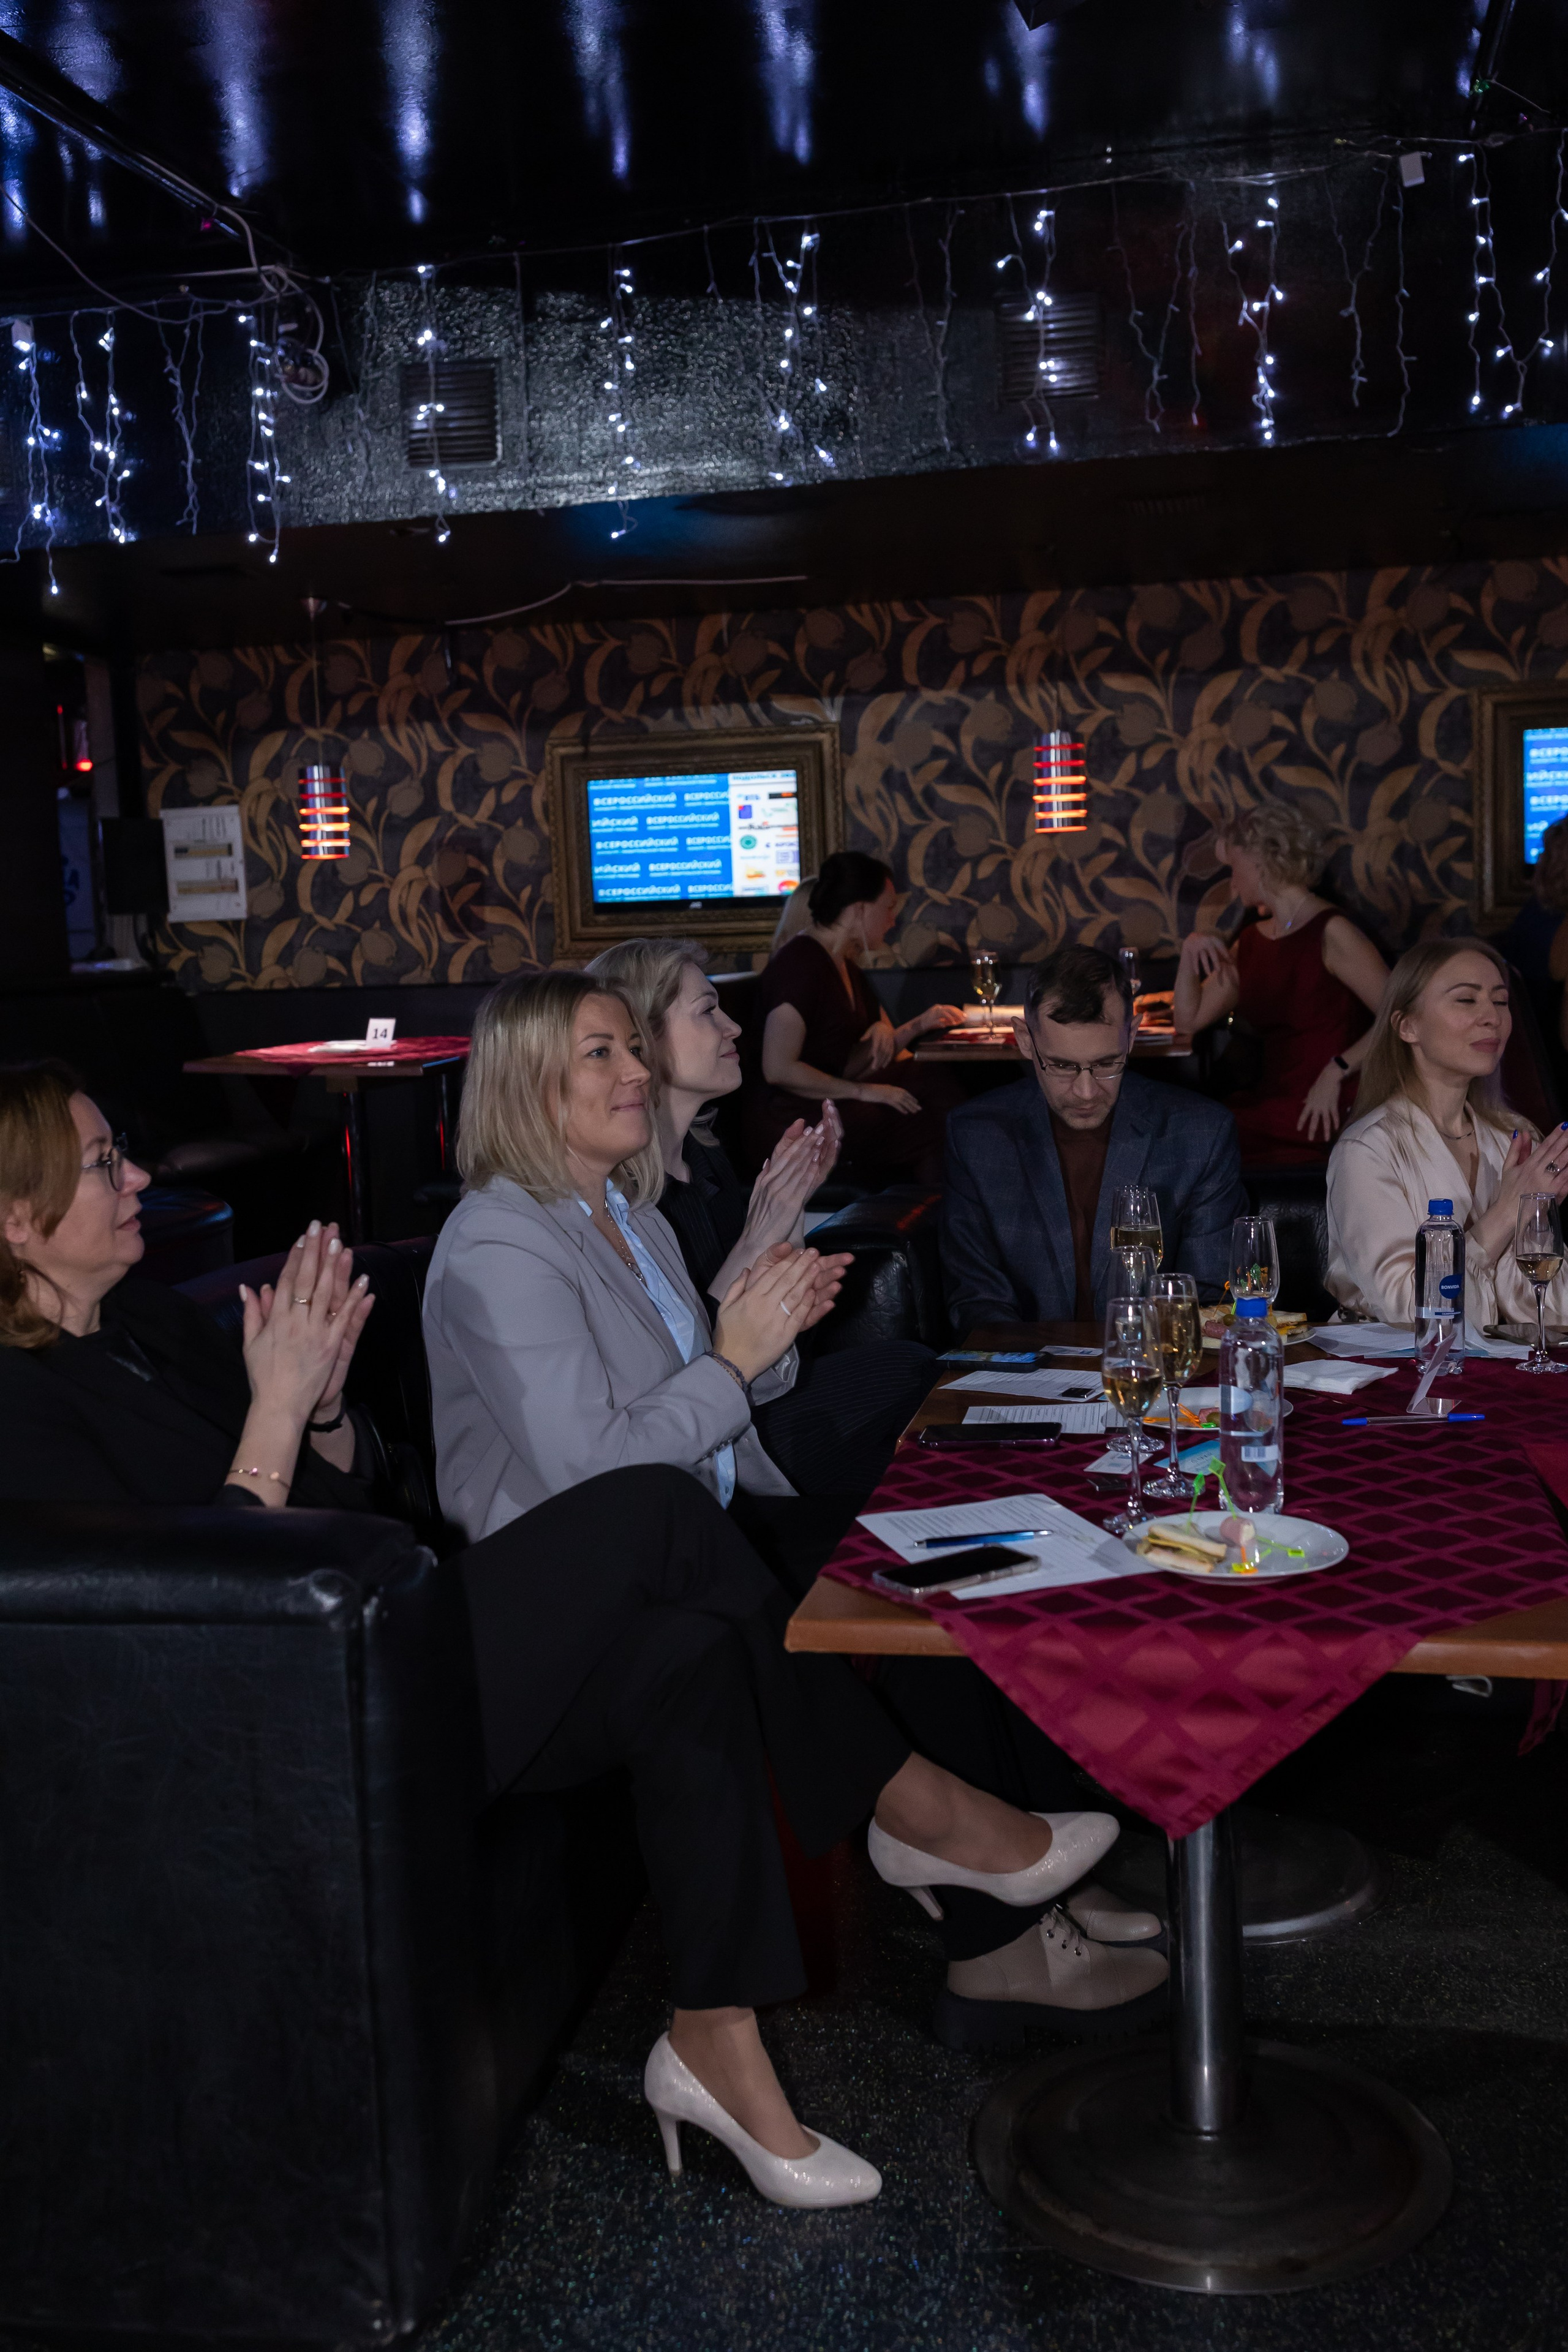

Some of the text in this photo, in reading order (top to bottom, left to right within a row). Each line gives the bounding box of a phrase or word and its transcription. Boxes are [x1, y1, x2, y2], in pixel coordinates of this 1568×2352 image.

[594, 792, 677, 806] ВСЕРОССИЙСКИЙ
[646, 812, 720, 825] ВСЕРОССИЙСКИЙ
[596, 837, 679, 850] ВСЕРОССИЙСКИЙ
[649, 859, 722, 871] ВСЕРОССИЙСКИЙ
[598, 884, 680, 896] ВСЕРОССИЙСКИЙ
[372, 1028, 387, 1039] 14
